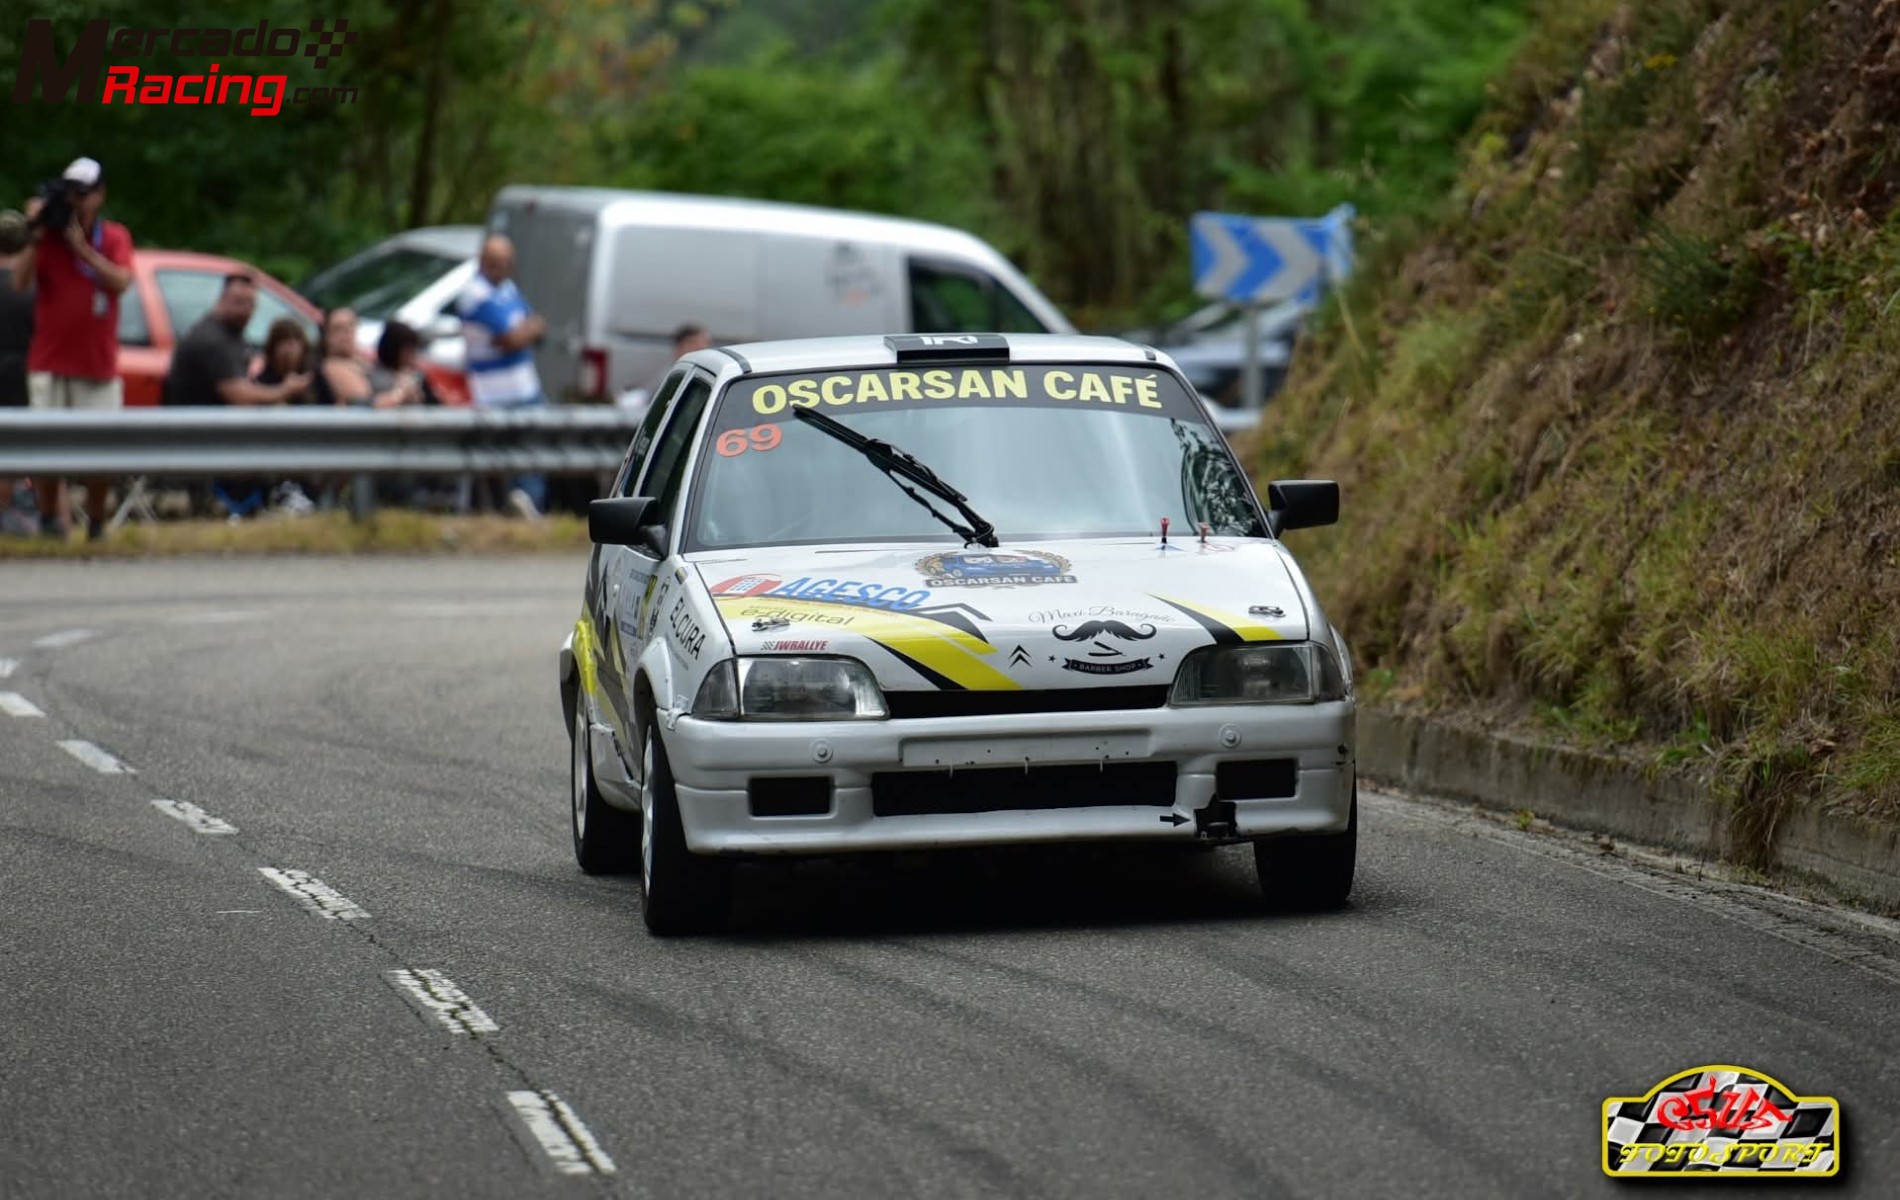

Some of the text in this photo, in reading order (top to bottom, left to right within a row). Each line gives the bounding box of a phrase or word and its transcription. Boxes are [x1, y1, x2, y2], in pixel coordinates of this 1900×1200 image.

[752, 370, 1163, 415] OSCARSAN CAFÉ
[715, 423, 783, 457] 69
[930, 576, 1026, 587] OSCARSAN
[770, 577, 932, 610] AGESCO
[773, 640, 829, 651] JWRALLYE
[1079, 663, 1137, 672] BARBER SHOP
